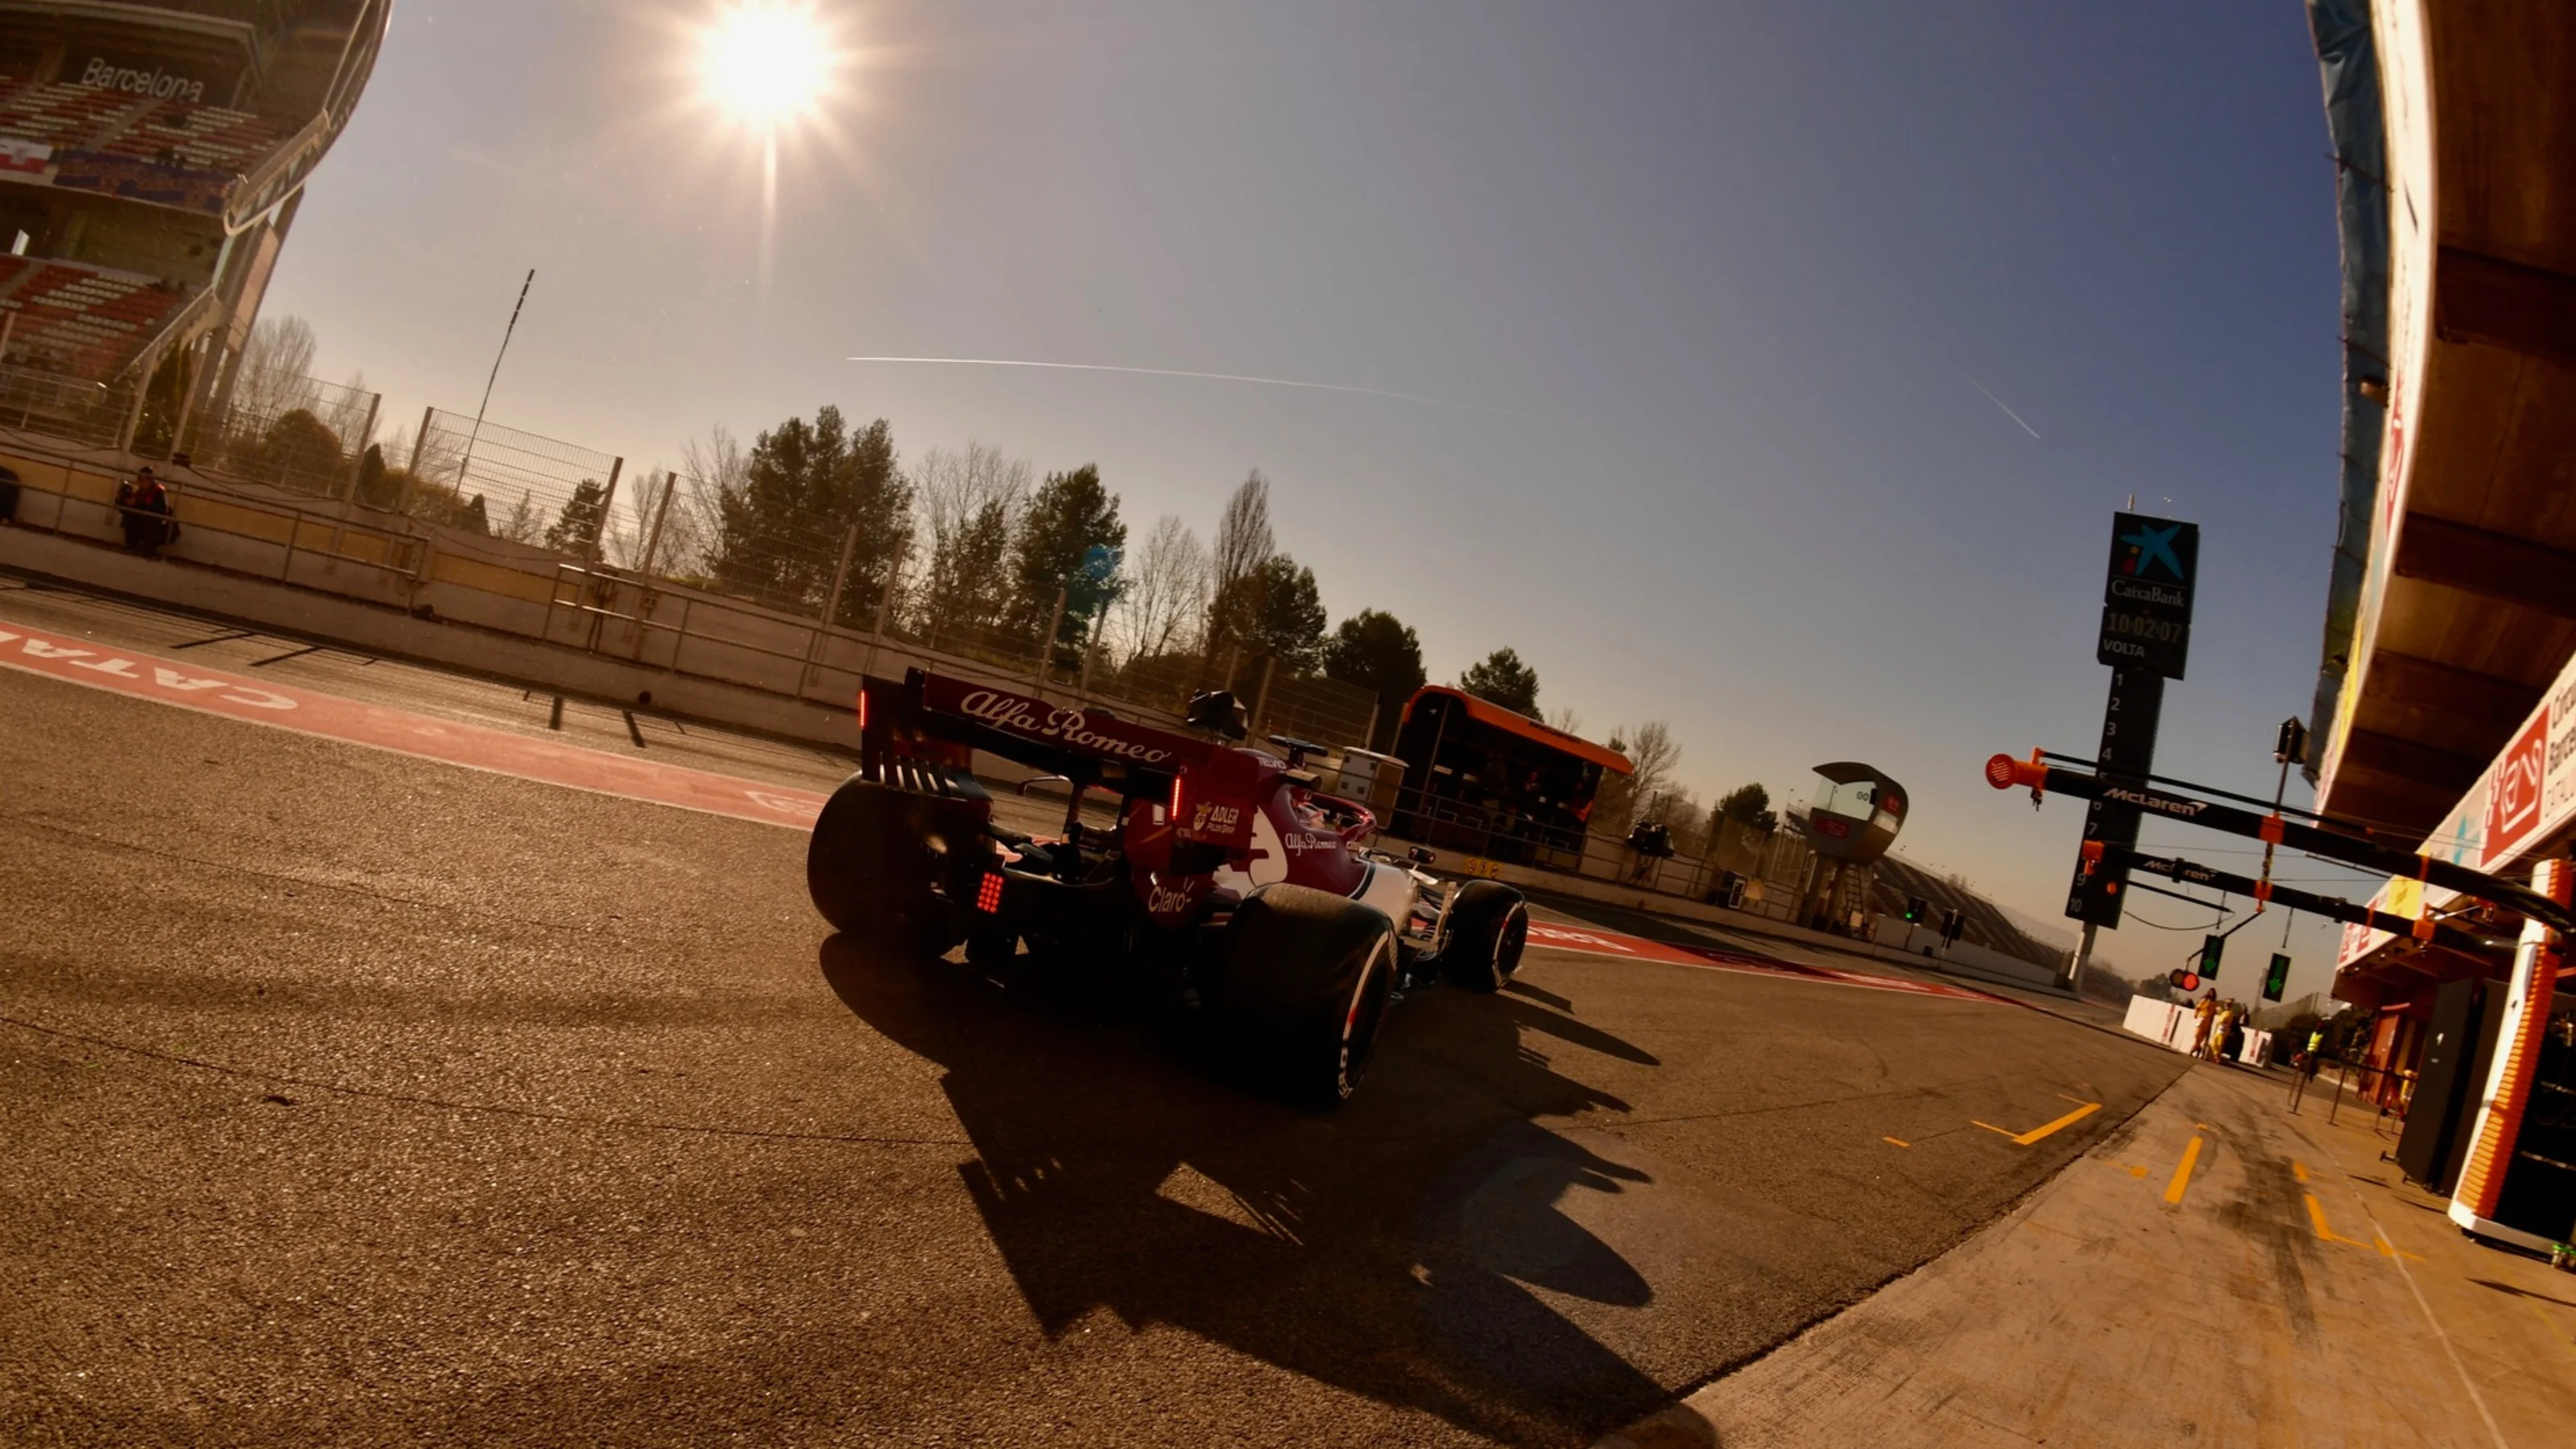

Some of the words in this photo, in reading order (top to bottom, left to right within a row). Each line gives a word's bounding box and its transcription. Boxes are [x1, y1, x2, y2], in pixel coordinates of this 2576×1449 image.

[81, 56, 205, 103] Barcelona
[2111, 579, 2185, 607] CaixaBank
[2102, 638, 2145, 658] VOLTA
[0, 630, 300, 709] CATA
[2115, 673, 2124, 687] 1
[2110, 697, 2121, 711] 2
[961, 691, 1041, 729] Alfa
[1040, 709, 1172, 763] Romeo
[2107, 721, 2116, 737] 3
[2101, 747, 2111, 762] 4
[2103, 787, 2195, 816] McLaren
[1209, 805, 1239, 825] ADLER
[2088, 822, 2098, 836] 7
[1285, 833, 1308, 857] Alfa
[1305, 833, 1337, 849] Romeo
[2077, 873, 2086, 886] 9
[2143, 861, 2210, 881] McLren
[1148, 886, 1186, 914] Claro
[2069, 898, 2082, 913] 10
